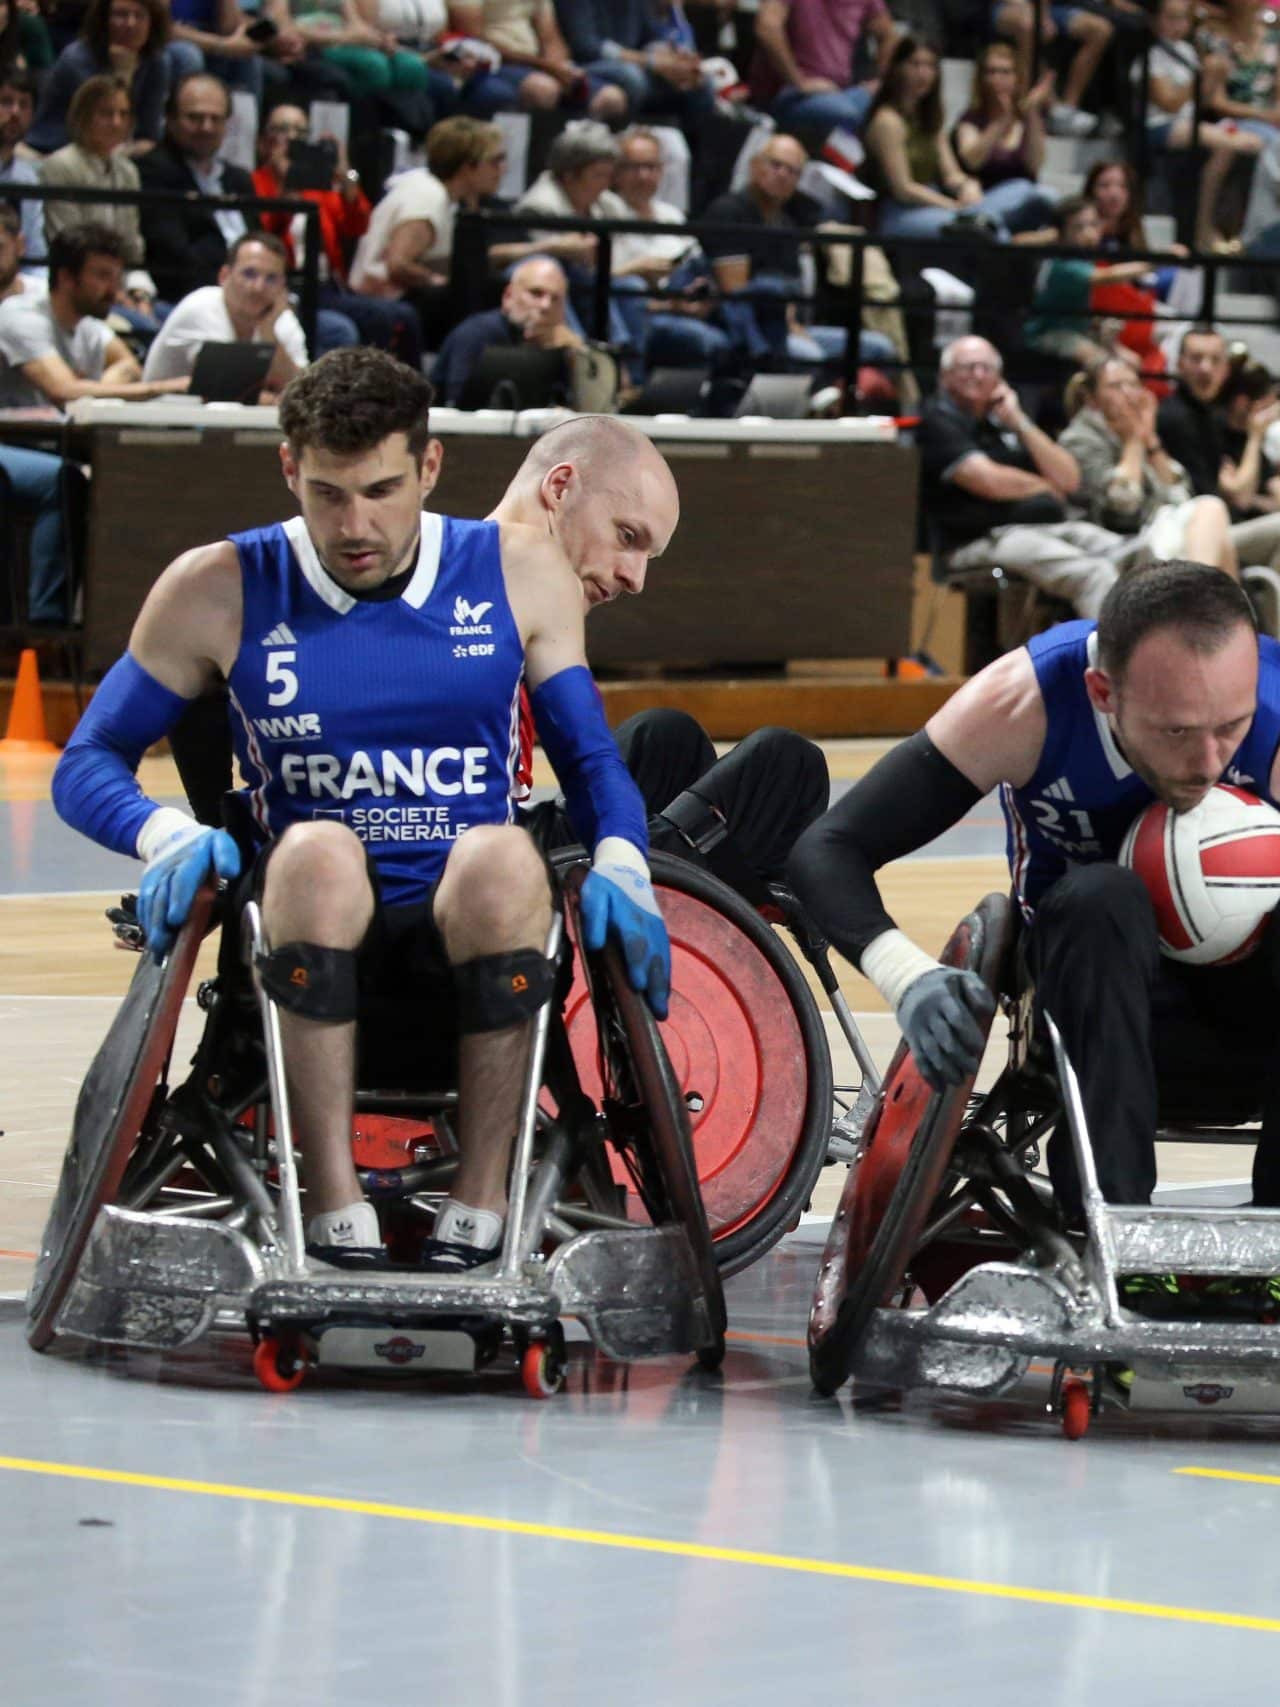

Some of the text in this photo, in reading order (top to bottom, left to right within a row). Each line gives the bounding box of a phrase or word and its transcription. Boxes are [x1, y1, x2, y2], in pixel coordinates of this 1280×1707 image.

[265, 650, 299, 706] 5
[280, 746, 489, 800] FRANCE
[351, 806, 450, 824] SOCIETE
[354, 823, 469, 841] GENERALE
[1029, 799, 1095, 839] 21
